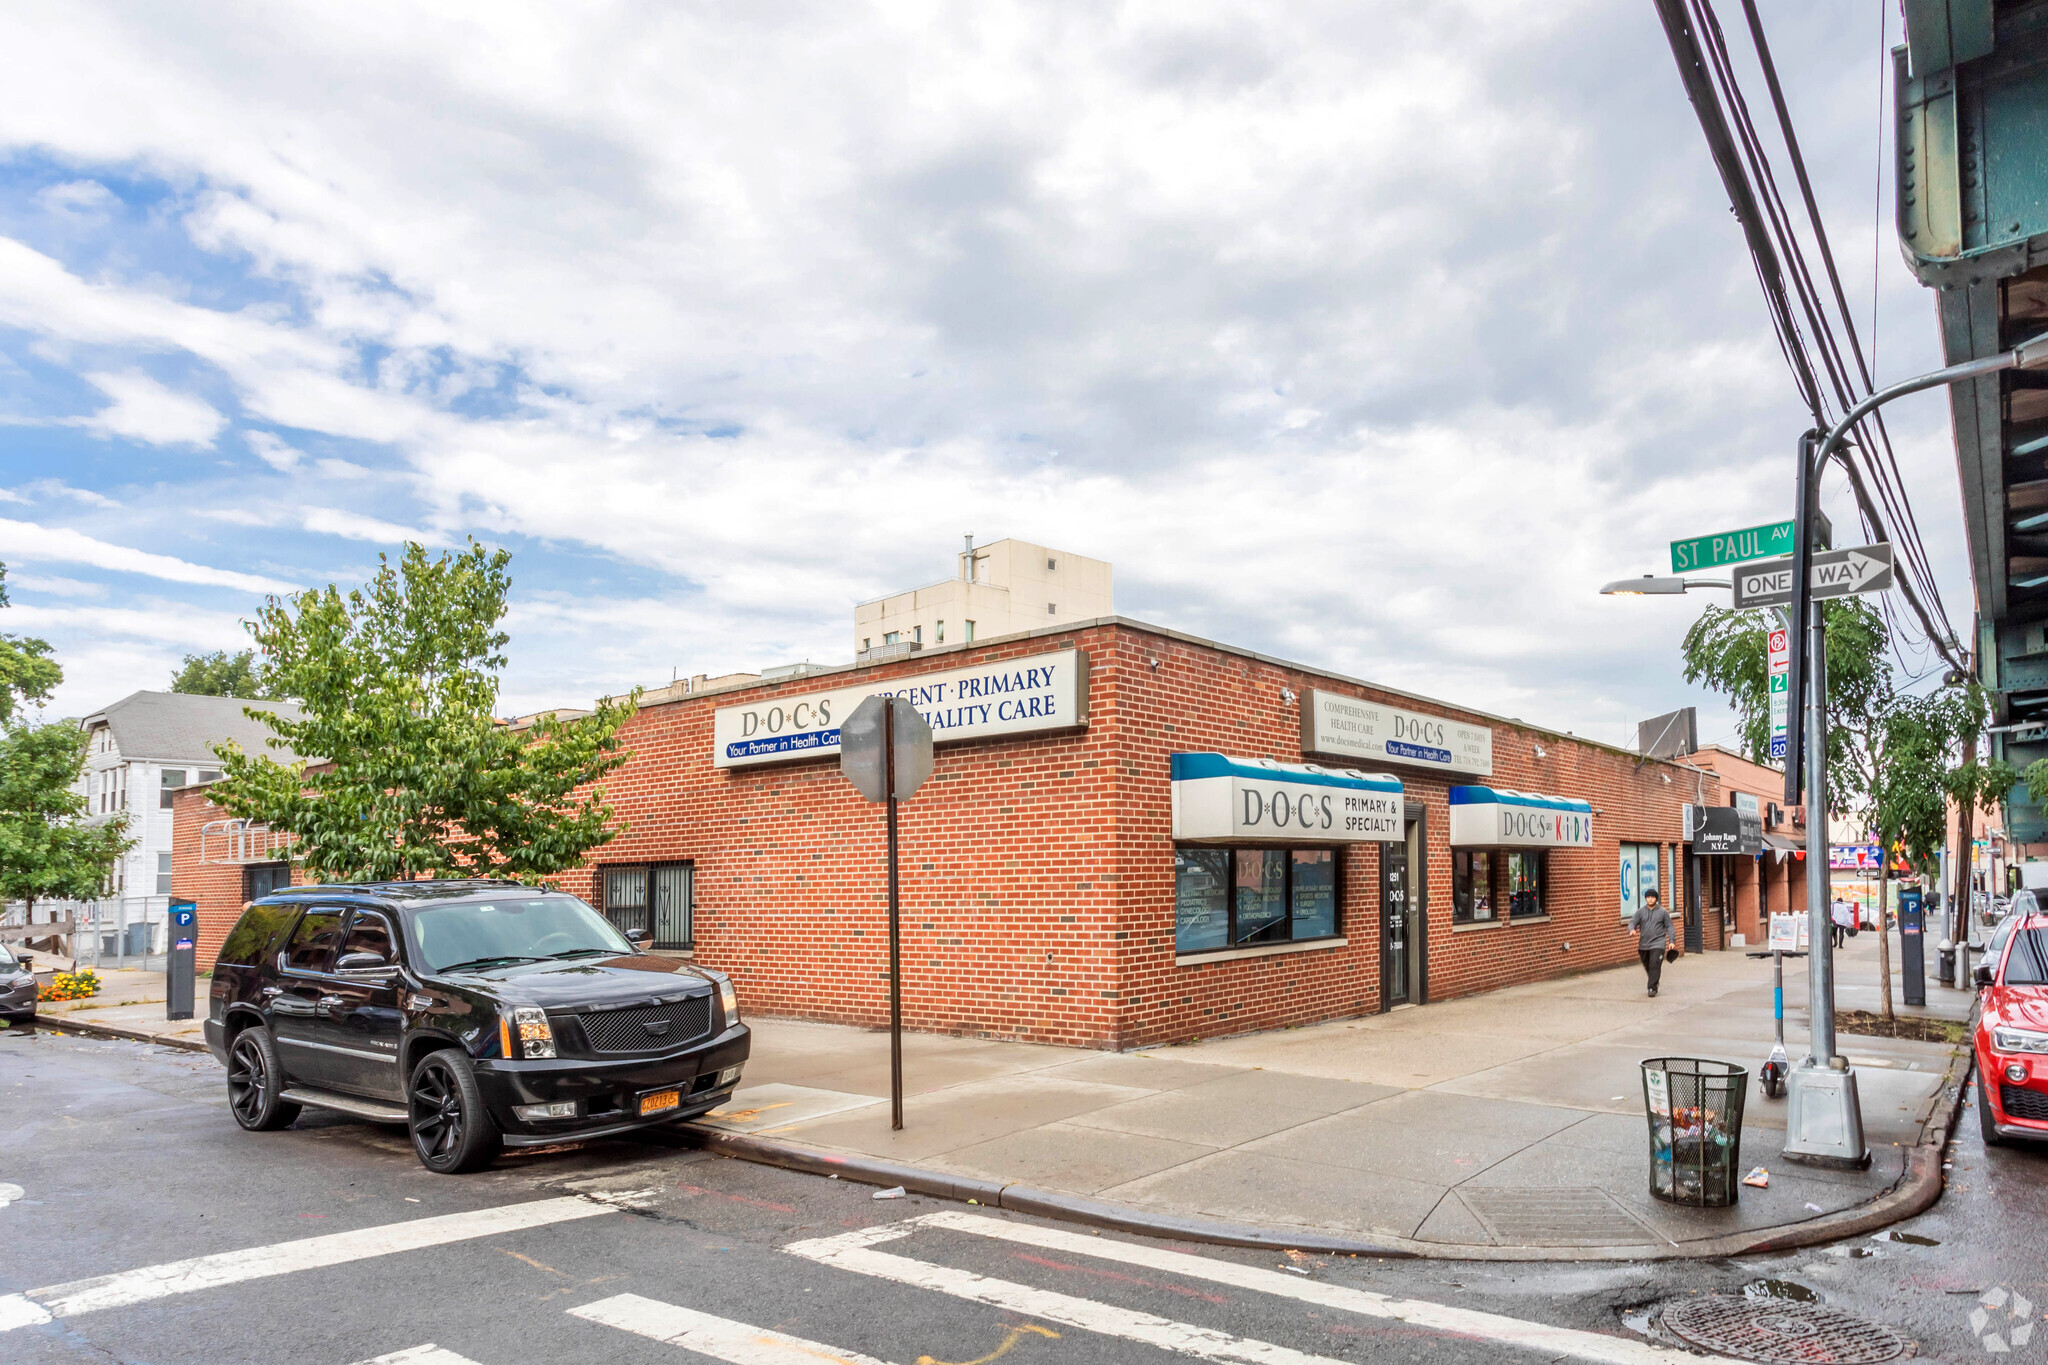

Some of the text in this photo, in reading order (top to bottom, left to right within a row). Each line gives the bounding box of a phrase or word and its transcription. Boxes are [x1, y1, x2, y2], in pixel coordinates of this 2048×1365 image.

[1676, 525, 1790, 568] ST PAUL AV
[1747, 560, 1870, 595] ONE WAY
[958, 665, 1056, 700] PRIMARY
[1775, 675, 1783, 691] 2
[998, 694, 1056, 721] CARE
[1324, 701, 1379, 721] COMPREHENSIVE
[1331, 718, 1374, 735] HEALTH CARE
[1320, 735, 1383, 751] www.docsmedical.com
[1457, 730, 1470, 740] OPEN
[1474, 733, 1486, 743] DAYS
[729, 745, 747, 757] Your
[749, 741, 777, 755] Partner
[780, 738, 788, 750] in
[790, 733, 819, 749] Health
[1387, 742, 1451, 763] Your Partner in Health Care
[1467, 744, 1481, 755] WEEK
[1345, 797, 1397, 814] PRIMARY &
[1345, 817, 1397, 832] SPECIALTY
[1702, 832, 1722, 843] Johnny
[1723, 833, 1737, 843] Rags
[1204, 888, 1225, 897] MEDICINE
[181, 913, 190, 924] P
[1180, 906, 1212, 915] GYNECOLOGY
